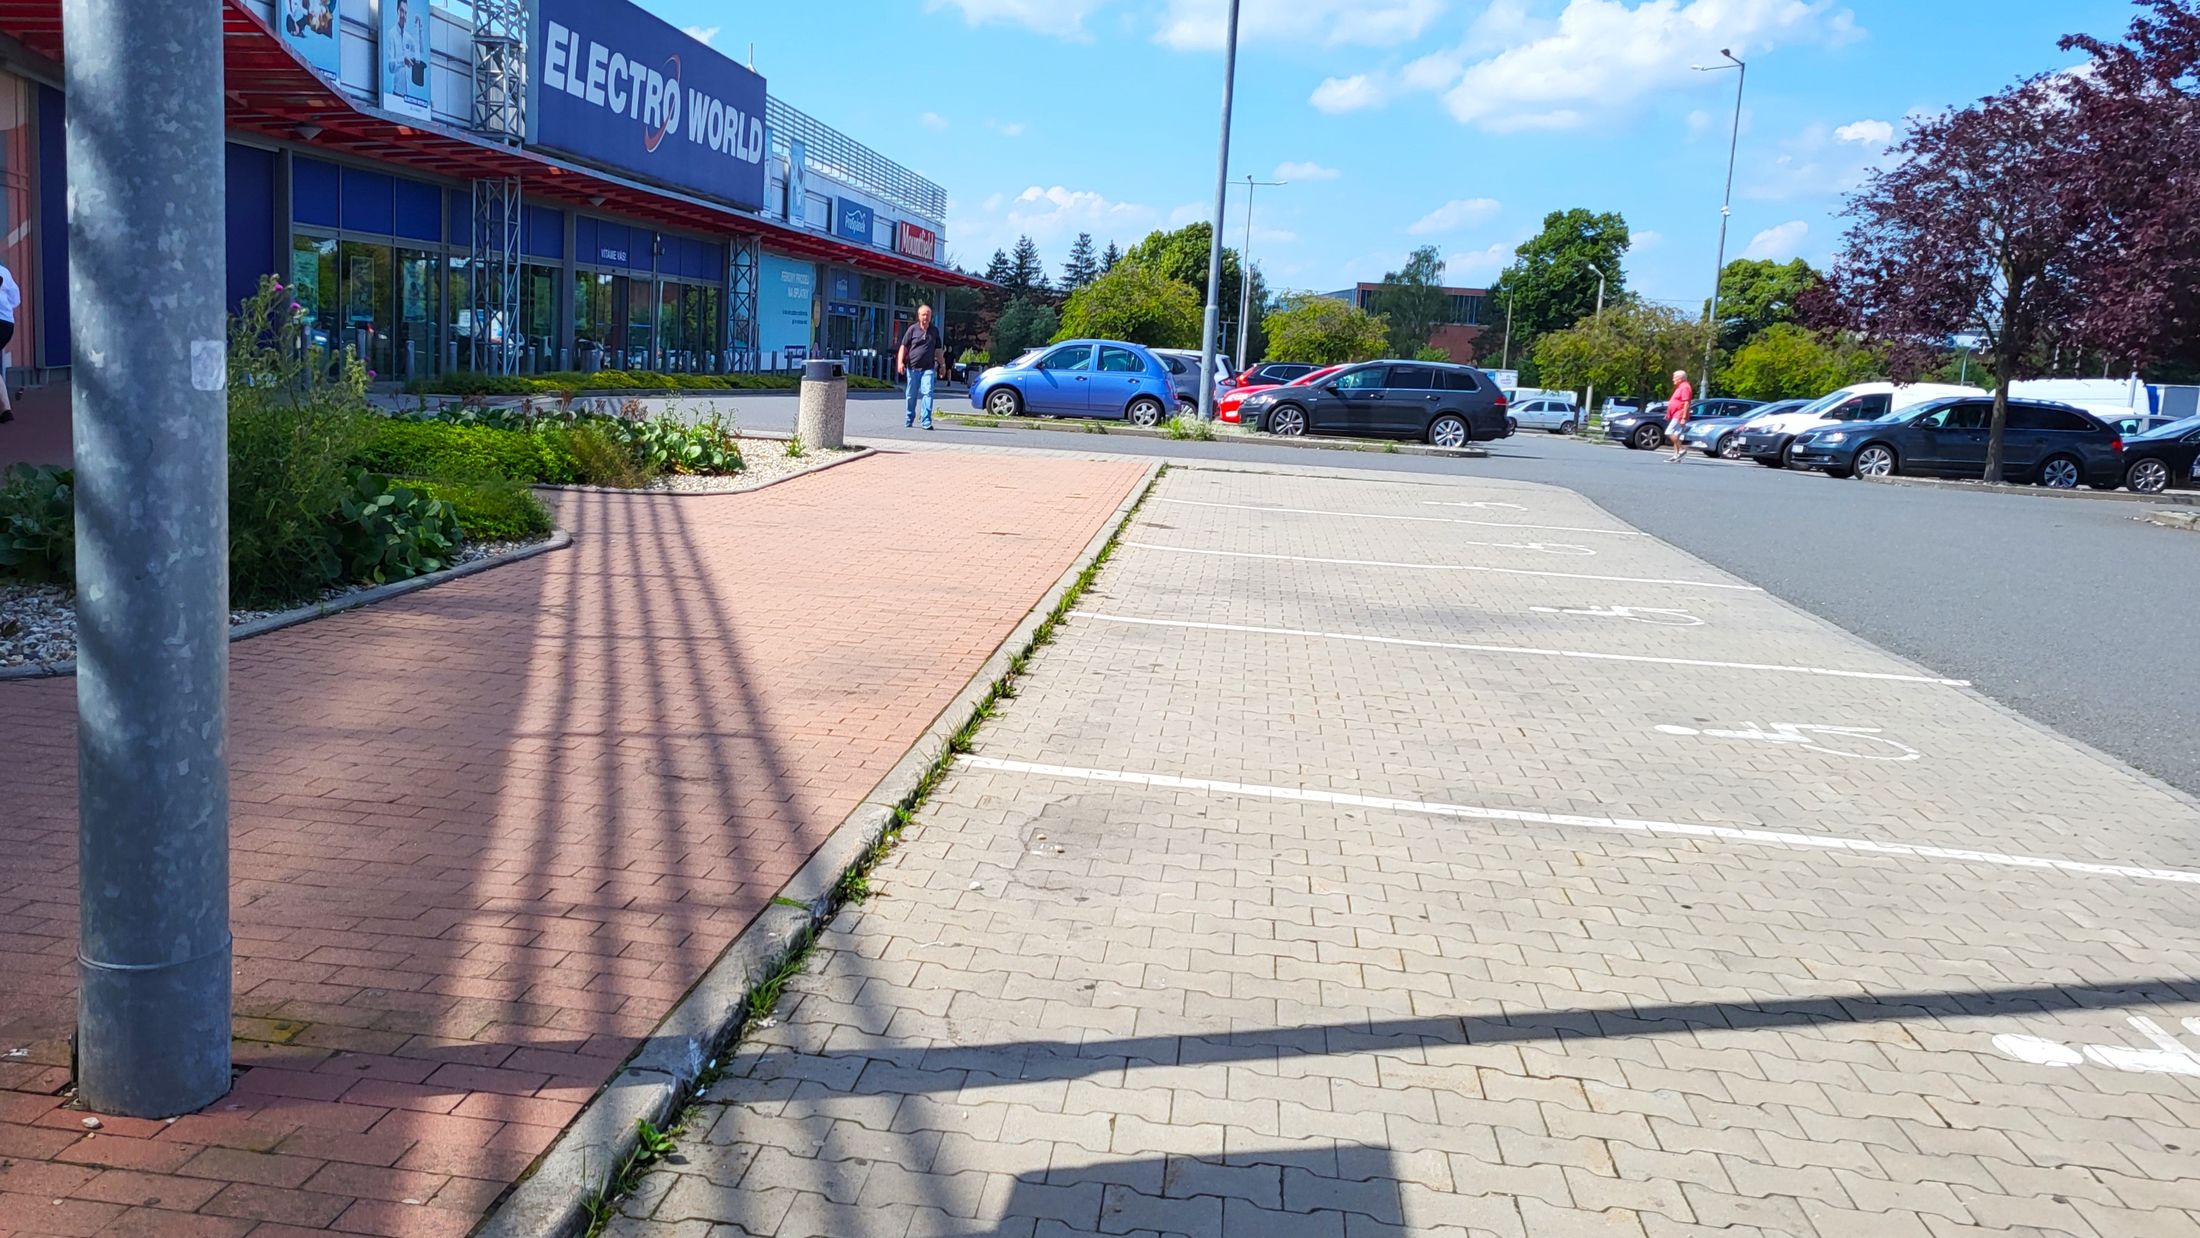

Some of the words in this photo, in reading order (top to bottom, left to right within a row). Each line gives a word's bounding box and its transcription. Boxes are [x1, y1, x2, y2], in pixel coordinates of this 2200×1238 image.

[544, 20, 681, 135] ELECTRO
[688, 88, 763, 165] WORLD
[901, 223, 934, 260] Mountfield
